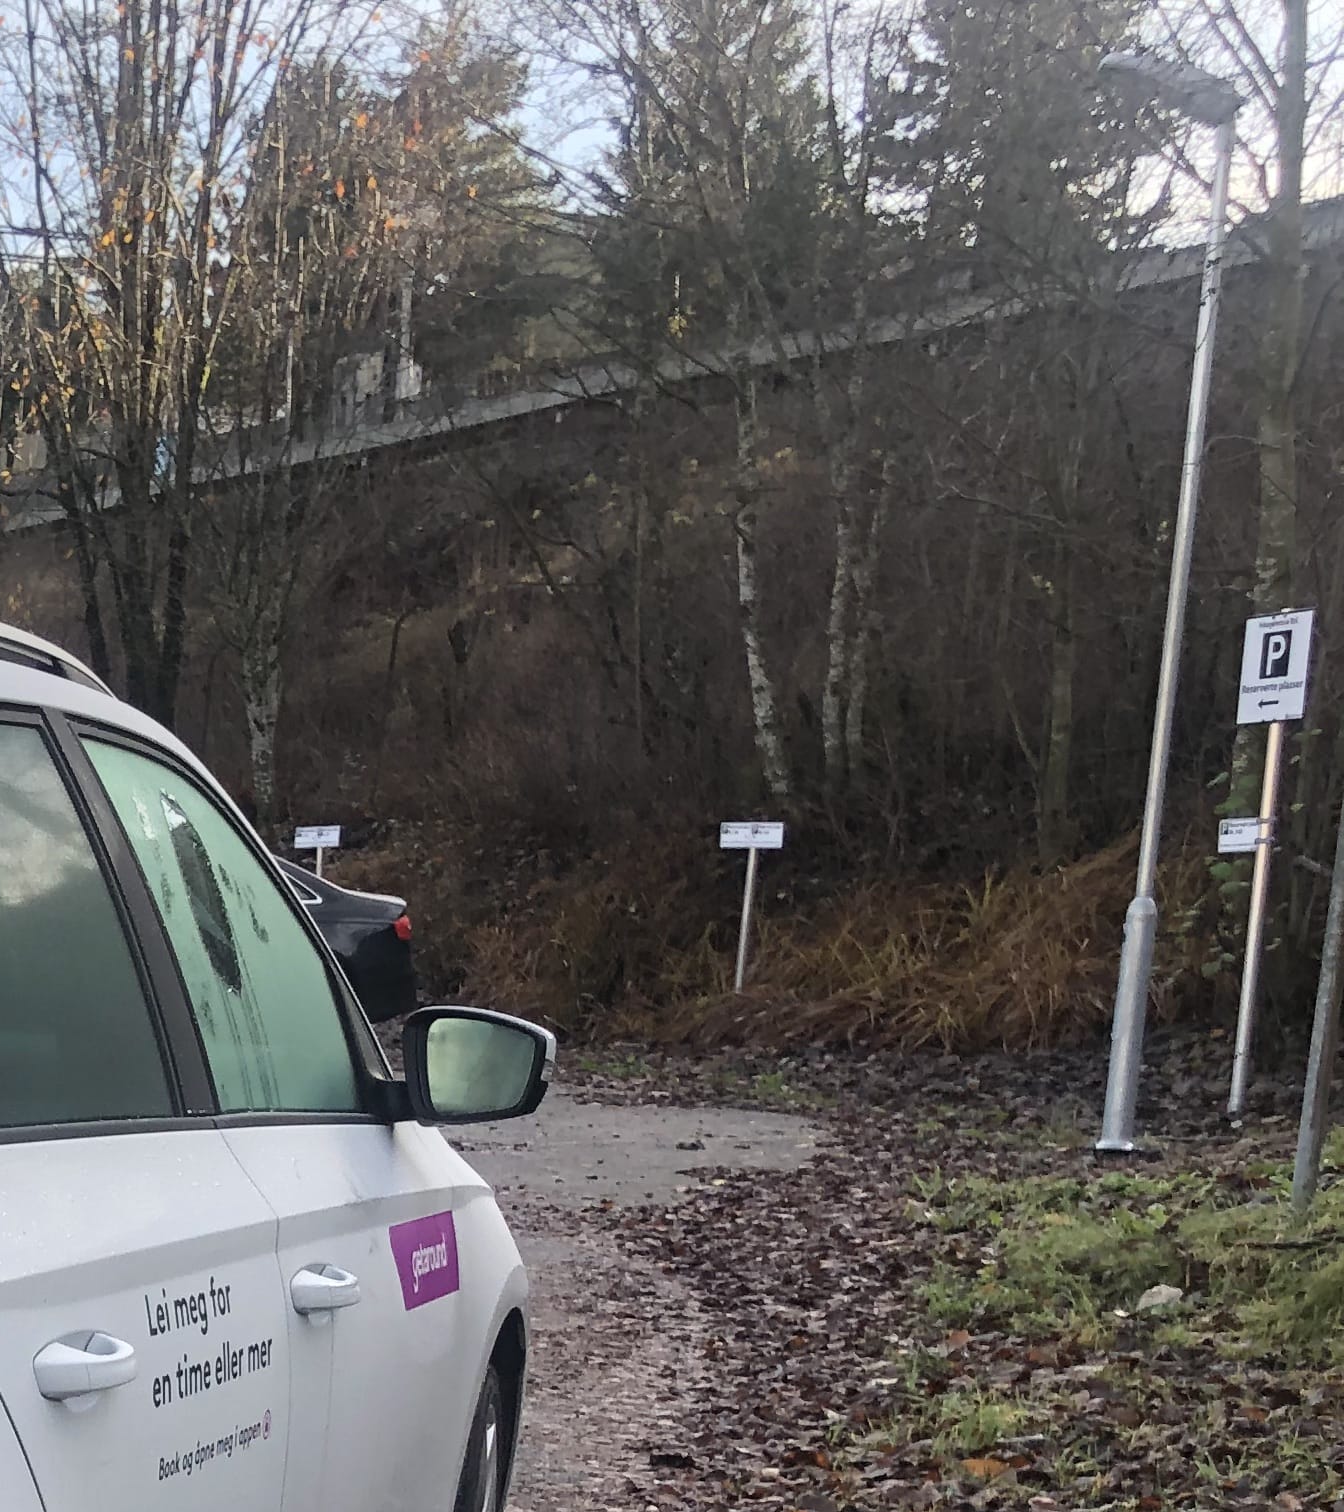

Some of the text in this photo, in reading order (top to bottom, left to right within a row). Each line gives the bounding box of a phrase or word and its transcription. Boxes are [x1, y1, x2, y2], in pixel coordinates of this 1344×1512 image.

[1266, 634, 1286, 677] P
[145, 1276, 231, 1337] Lei meg for
[152, 1338, 273, 1408] en time eller mer
[158, 1451, 180, 1481] Book
[182, 1451, 194, 1476] og
[216, 1433, 233, 1458] meg
[234, 1424, 239, 1448] i
[239, 1422, 261, 1451] appen
